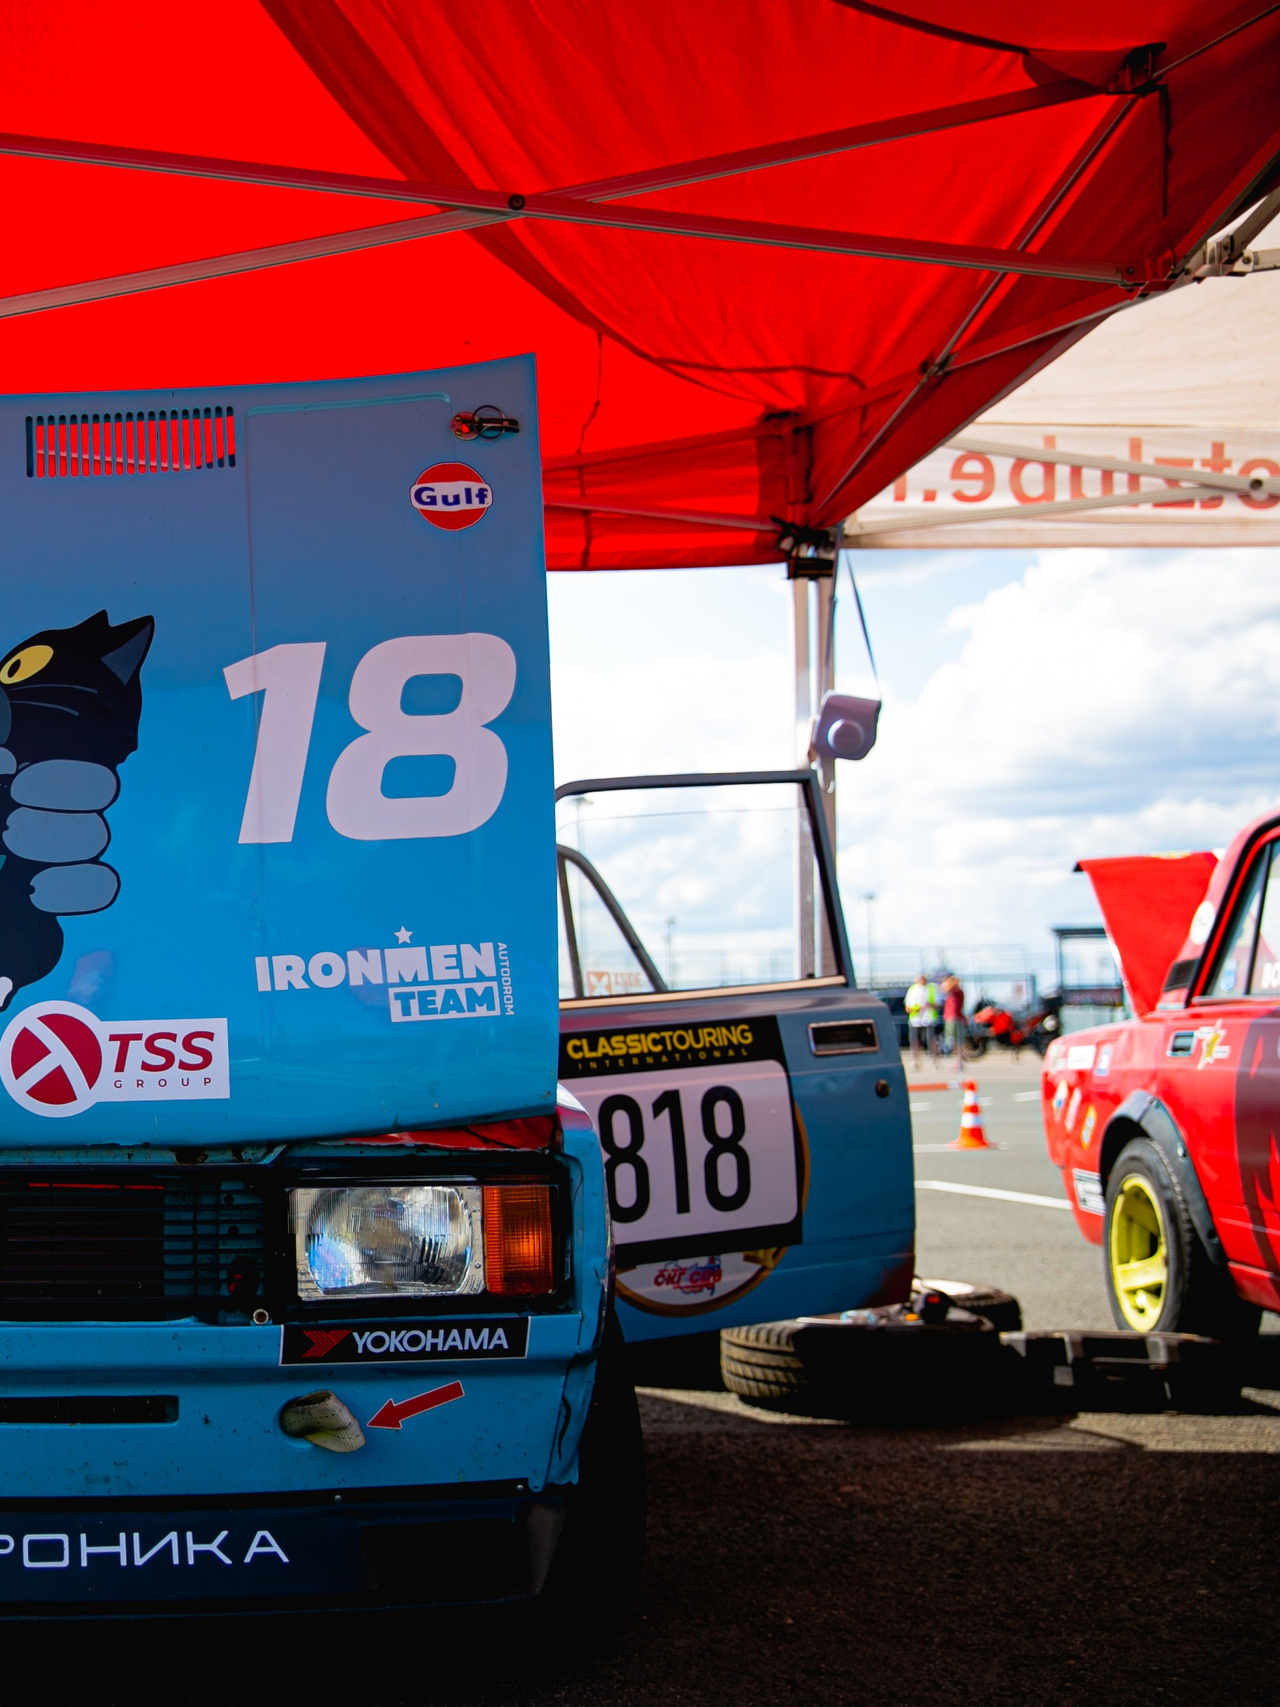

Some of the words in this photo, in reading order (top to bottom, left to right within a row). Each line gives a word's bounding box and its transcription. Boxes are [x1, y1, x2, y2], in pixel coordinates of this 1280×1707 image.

[413, 486, 489, 507] Gulf
[222, 631, 517, 844] 18
[254, 941, 498, 992] IRONMEN
[497, 942, 515, 1016] AUTODROM
[392, 984, 497, 1018] TEAM
[108, 1030, 215, 1073] TSS
[577, 1047, 749, 1070] INTERNATIONAL
[113, 1076, 212, 1089] GROUP
[598, 1085, 752, 1224] 818
[351, 1327, 509, 1354] YOKOHAMA
